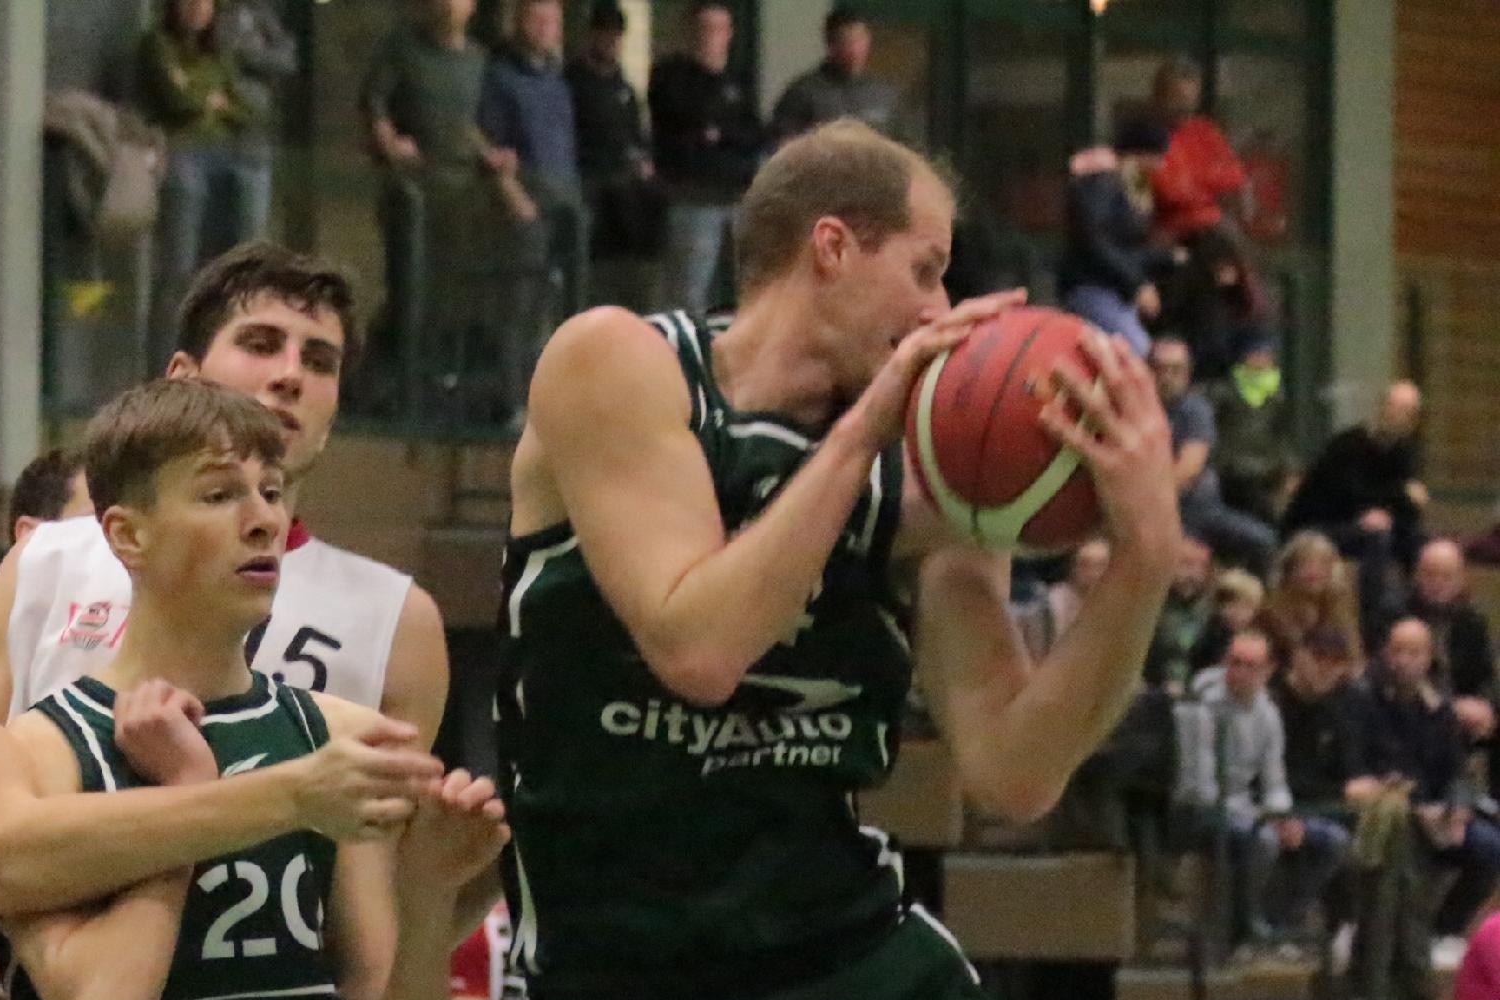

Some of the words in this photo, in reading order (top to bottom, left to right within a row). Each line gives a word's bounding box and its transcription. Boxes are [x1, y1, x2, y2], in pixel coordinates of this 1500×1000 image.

[601, 700, 853, 755] cityAuto
[701, 740, 843, 778] partner
[197, 852, 325, 961] 20
